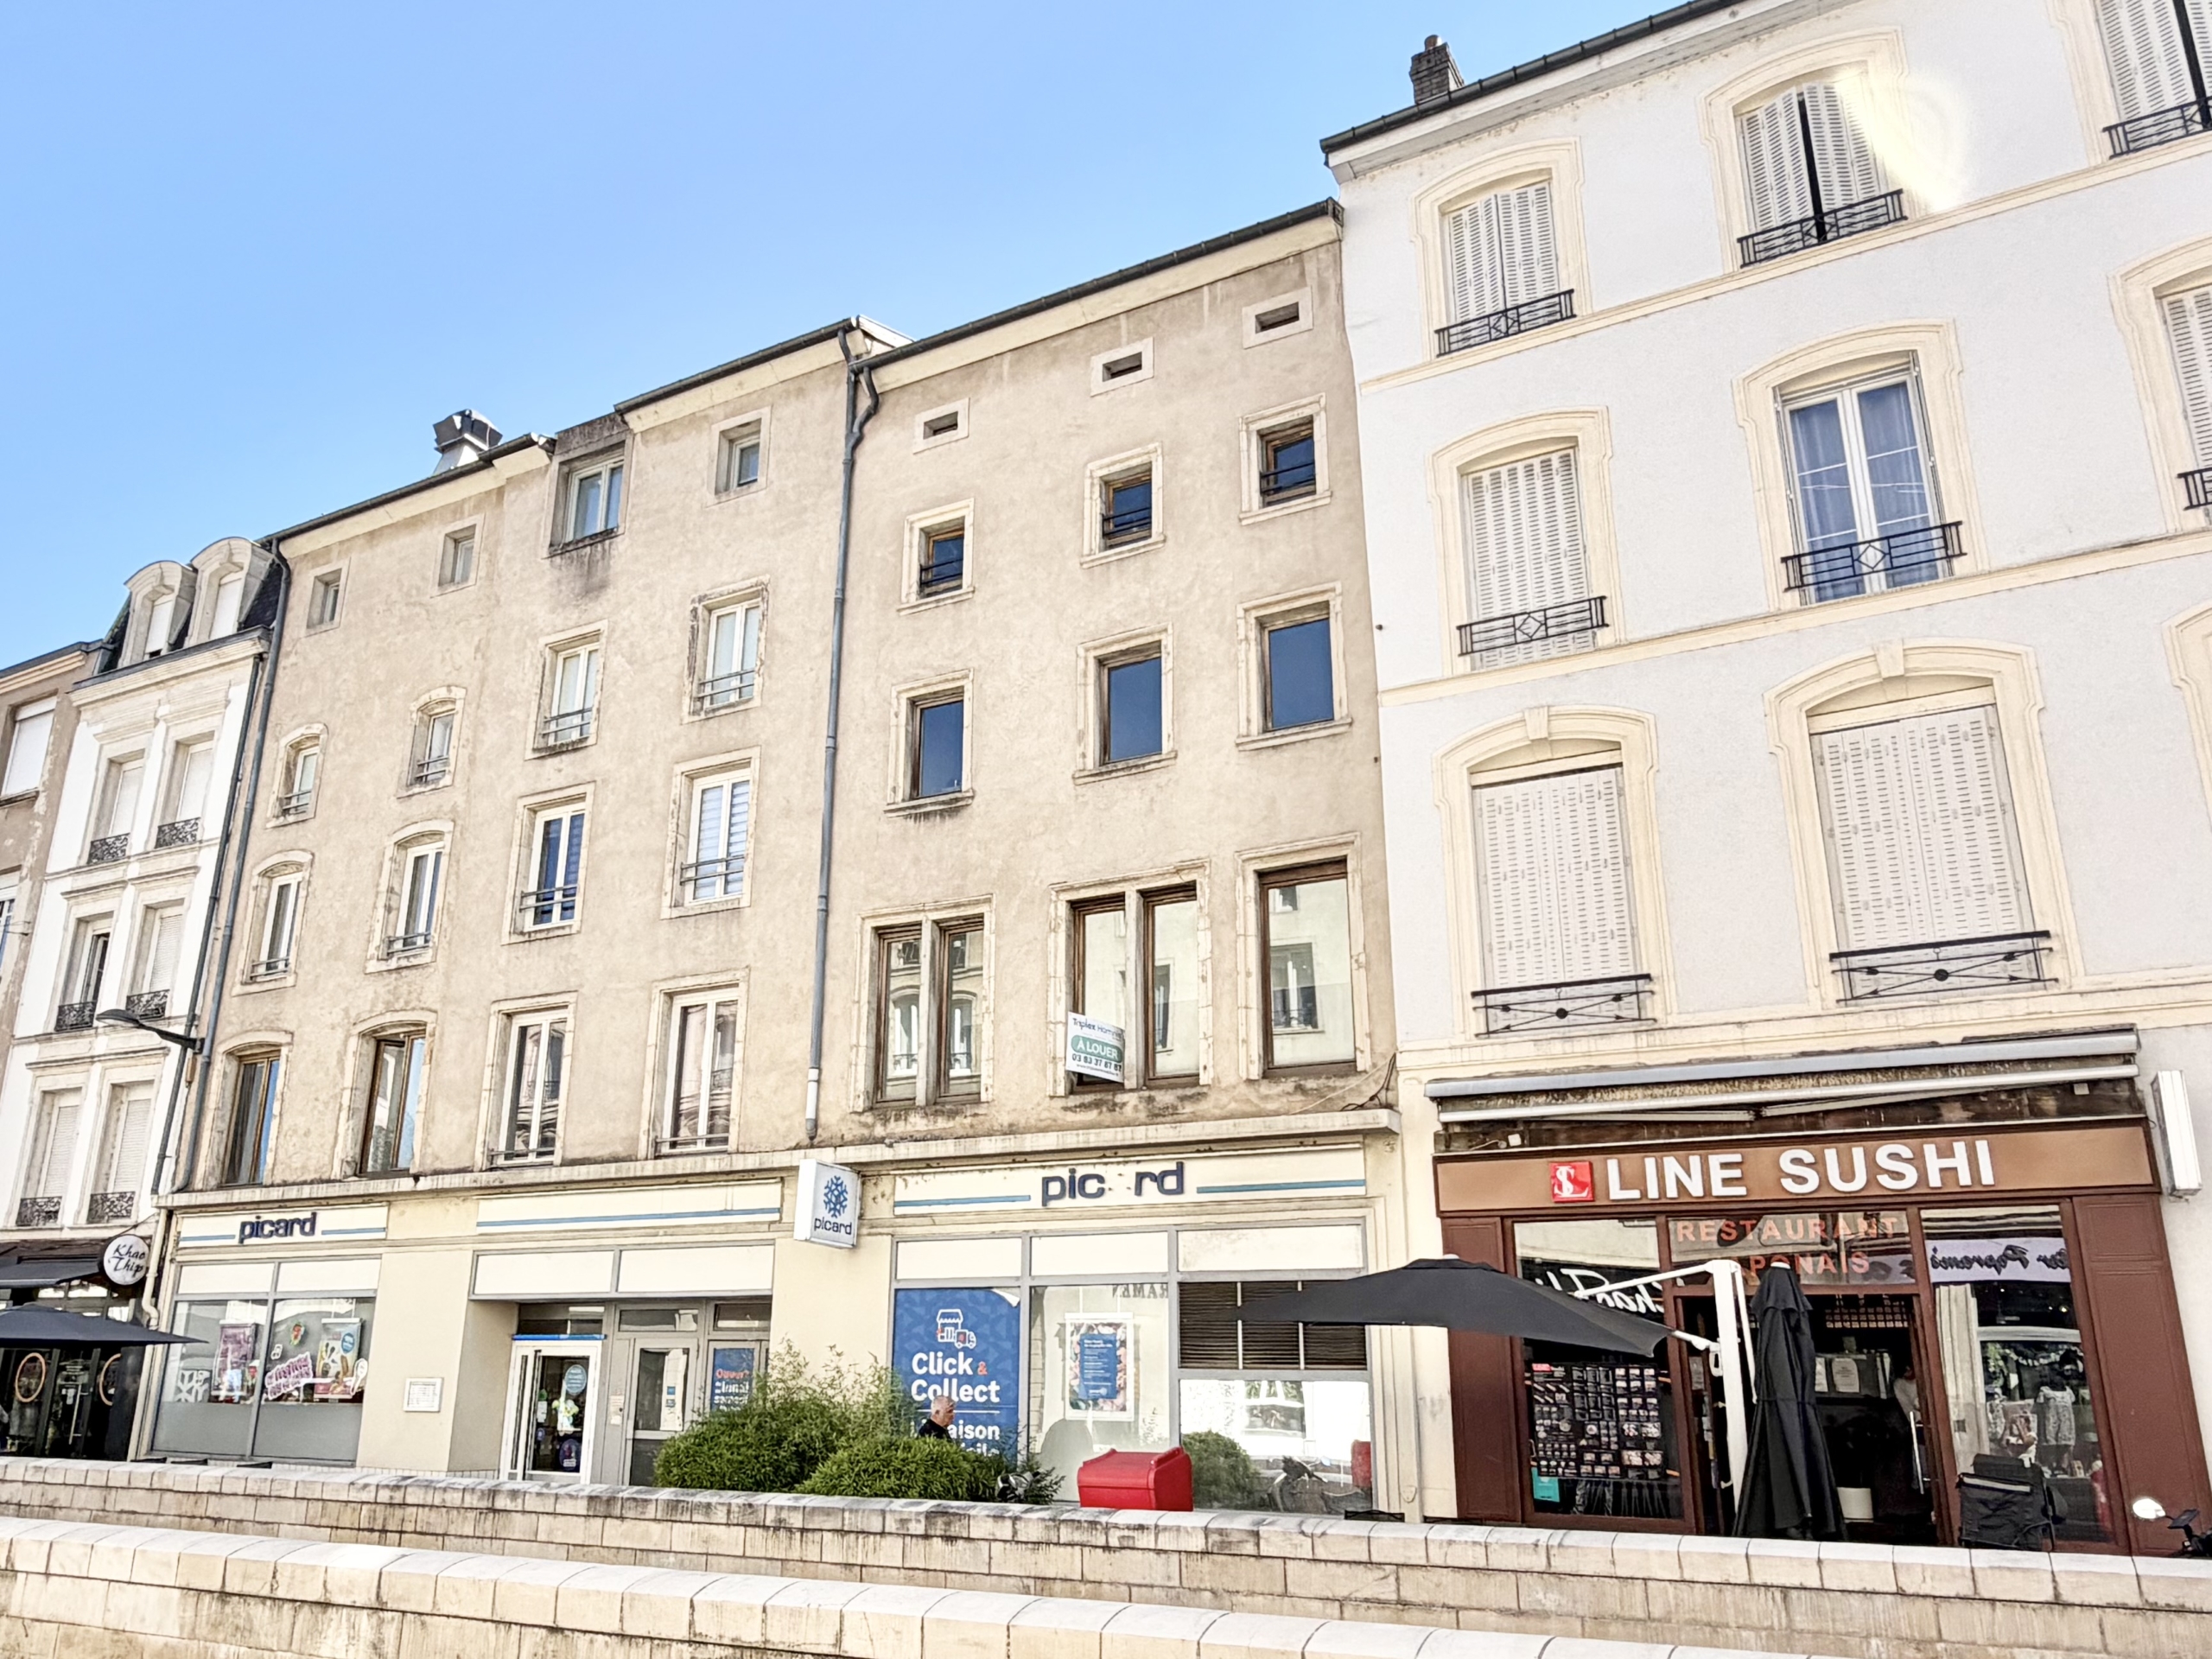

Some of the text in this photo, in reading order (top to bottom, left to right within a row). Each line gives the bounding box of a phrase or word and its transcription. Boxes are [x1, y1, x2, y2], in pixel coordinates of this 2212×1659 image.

[1072, 1053, 1081, 1062] 03
[1086, 1041, 1118, 1060] LOUER
[1606, 1140, 1995, 1200] LINE SUSHI
[238, 1211, 317, 1244] picard
[814, 1217, 852, 1235] picard
[1677, 1217, 1898, 1242] RESTAURANT
[113, 1244, 145, 1259] Khao
[108, 1256, 143, 1278] Thip
[1732, 1252, 1870, 1274] PNAIS
[912, 1351, 988, 1376] Click &
[911, 1378, 1001, 1402] Collect
